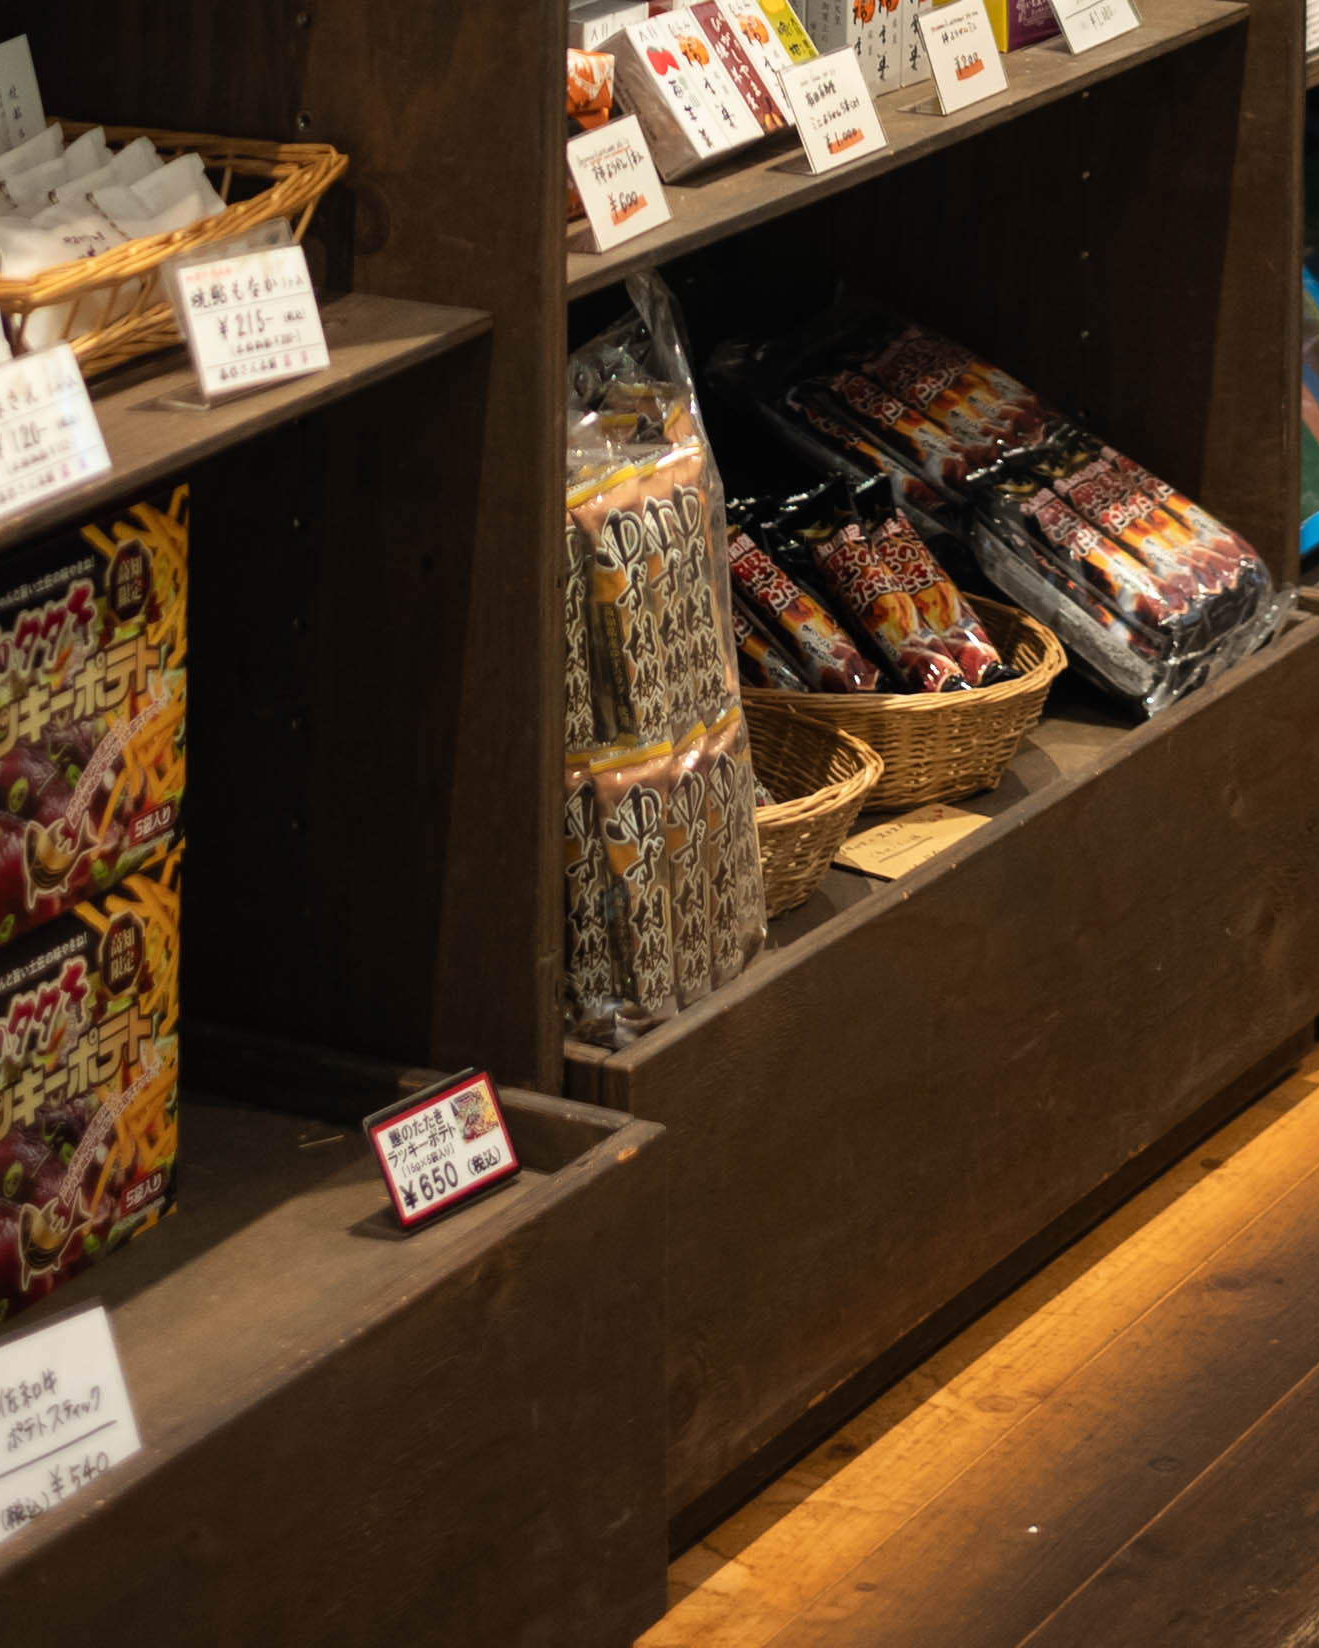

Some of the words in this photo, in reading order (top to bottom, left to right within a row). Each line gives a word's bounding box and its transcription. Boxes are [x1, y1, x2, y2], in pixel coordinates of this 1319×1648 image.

[387, 1108, 444, 1149] 鰹のたたき
[387, 1121, 456, 1169] ラッキーポテト
[398, 1160, 460, 1210] ¥650
[467, 1145, 502, 1176] (税込)
[6, 1384, 102, 1452] ポテトスティック
[49, 1450, 110, 1501] ¥540
